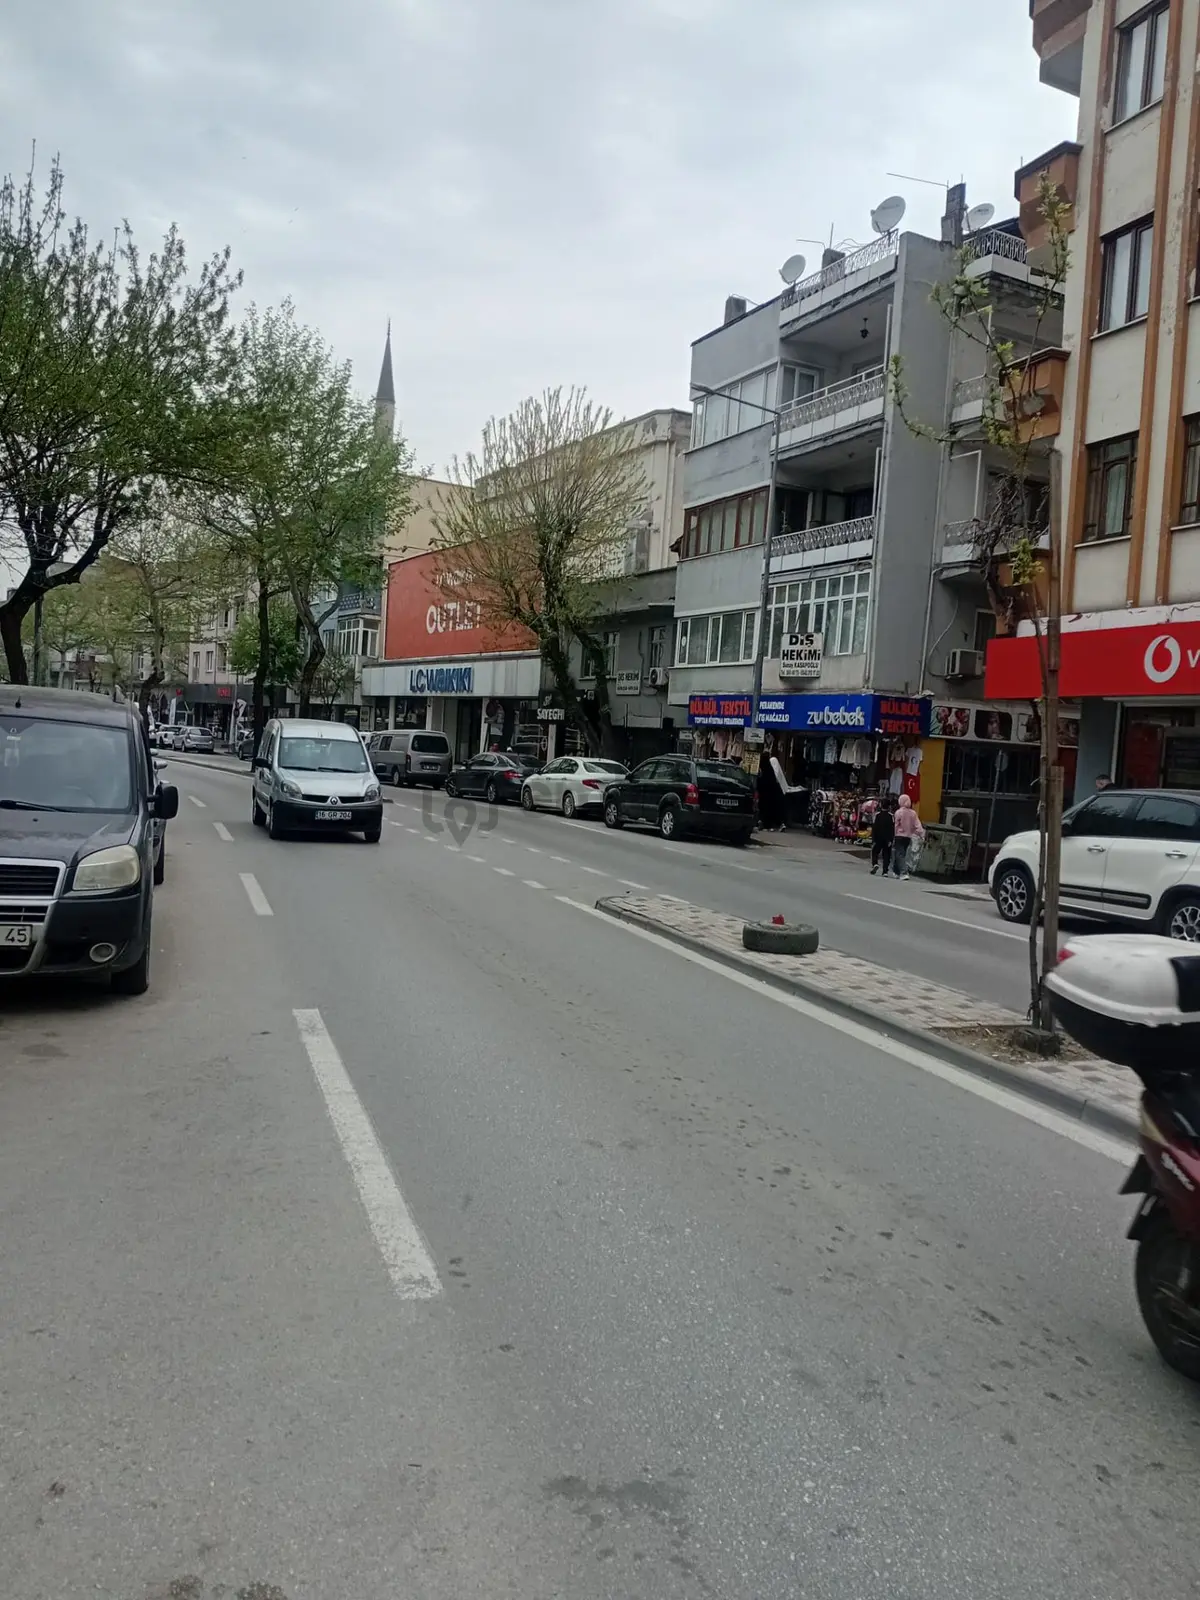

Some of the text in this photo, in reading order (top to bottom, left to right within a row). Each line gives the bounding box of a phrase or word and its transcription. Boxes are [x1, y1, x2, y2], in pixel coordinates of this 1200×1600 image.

[789, 634, 815, 648] DİŞ
[782, 649, 821, 661] HEKİMİ
[410, 669, 426, 692] LC
[691, 697, 751, 716] BÜLBÜL TEKSTİL
[880, 698, 920, 717] BÜLBÜL
[881, 717, 920, 734] TEKSTİL
[5, 928, 27, 943] 45
